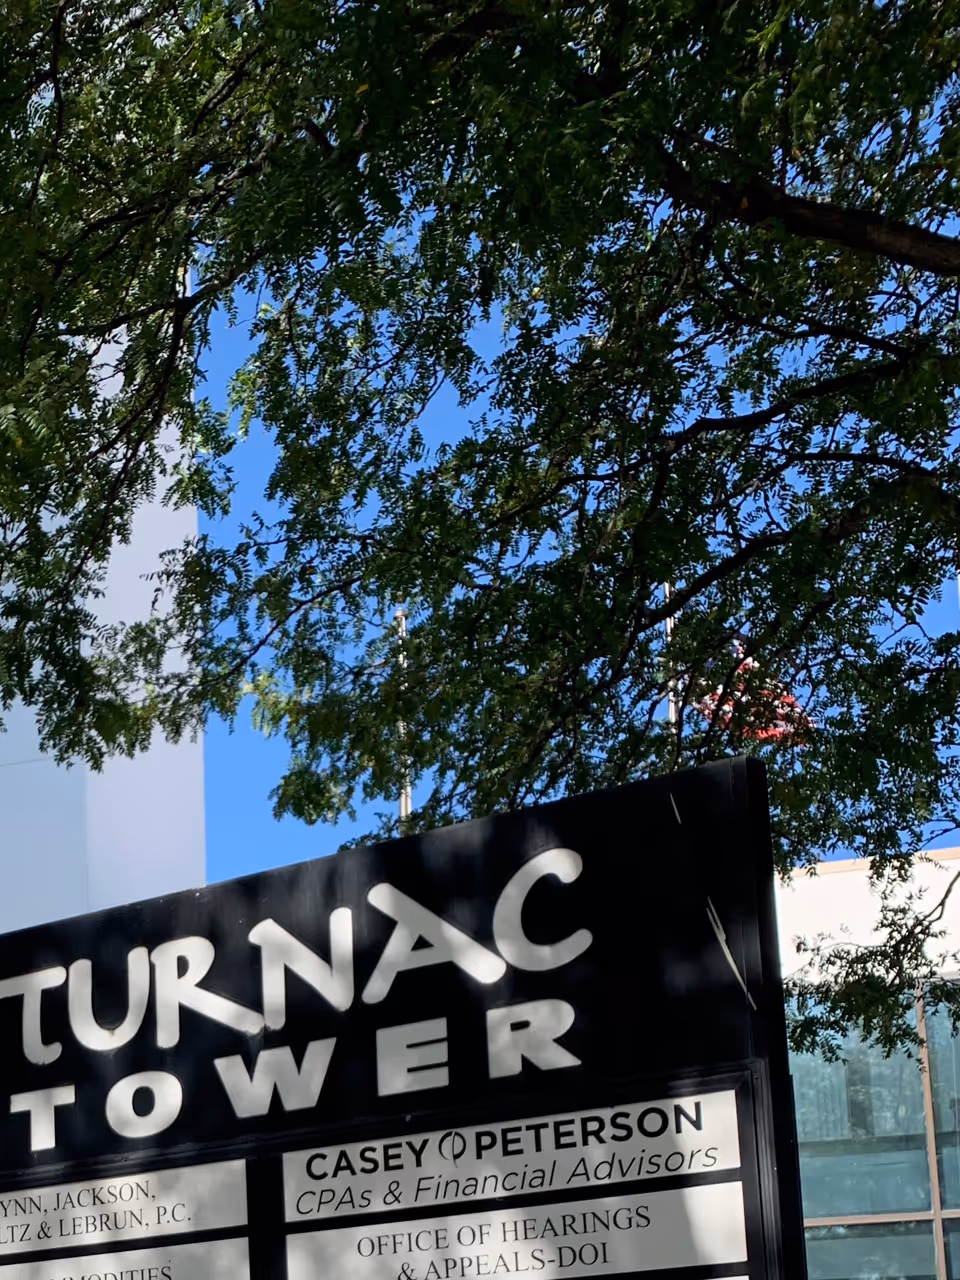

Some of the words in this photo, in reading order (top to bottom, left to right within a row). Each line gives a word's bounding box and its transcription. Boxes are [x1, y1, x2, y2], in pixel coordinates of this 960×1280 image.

[9, 999, 582, 1153] TOWER
[305, 1139, 430, 1181] CASEY
[475, 1101, 703, 1160] PETERSON
[53, 1180, 157, 1211] JACKSON,
[295, 1184, 371, 1215] CPAs
[382, 1181, 403, 1206] &
[415, 1160, 556, 1202] Financial
[567, 1144, 719, 1185] Advisors
[37, 1220, 52, 1239] &
[59, 1209, 149, 1237] LEBRUN,
[156, 1203, 191, 1225] P.C.
[357, 1228, 450, 1257] OFFICE
[457, 1224, 492, 1246] OF
[501, 1206, 651, 1243] HEARINGS
